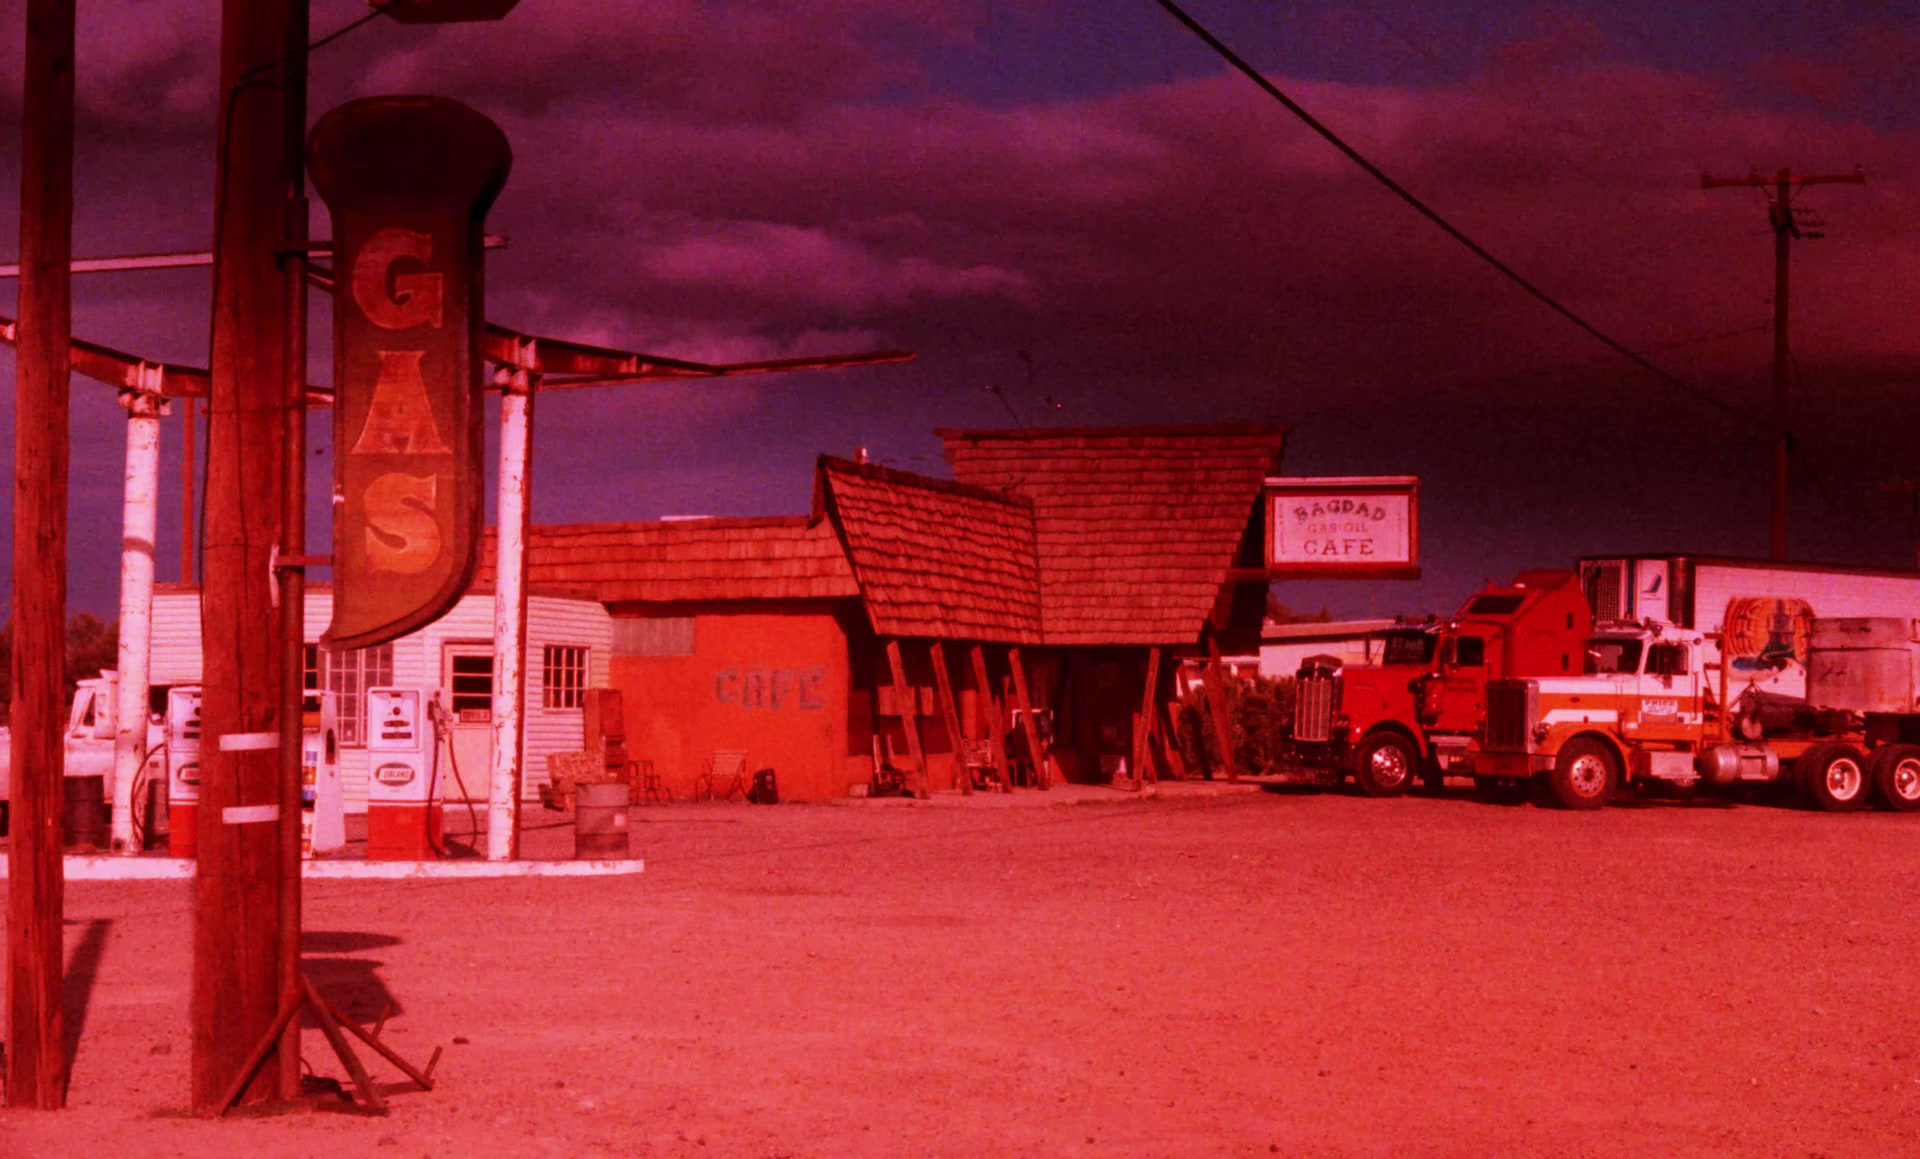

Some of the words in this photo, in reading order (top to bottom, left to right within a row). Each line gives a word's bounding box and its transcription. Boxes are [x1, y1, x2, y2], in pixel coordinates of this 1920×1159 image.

[350, 227, 453, 575] GAS
[1293, 499, 1386, 523] BAGDAD
[1304, 538, 1374, 556] CAFE
